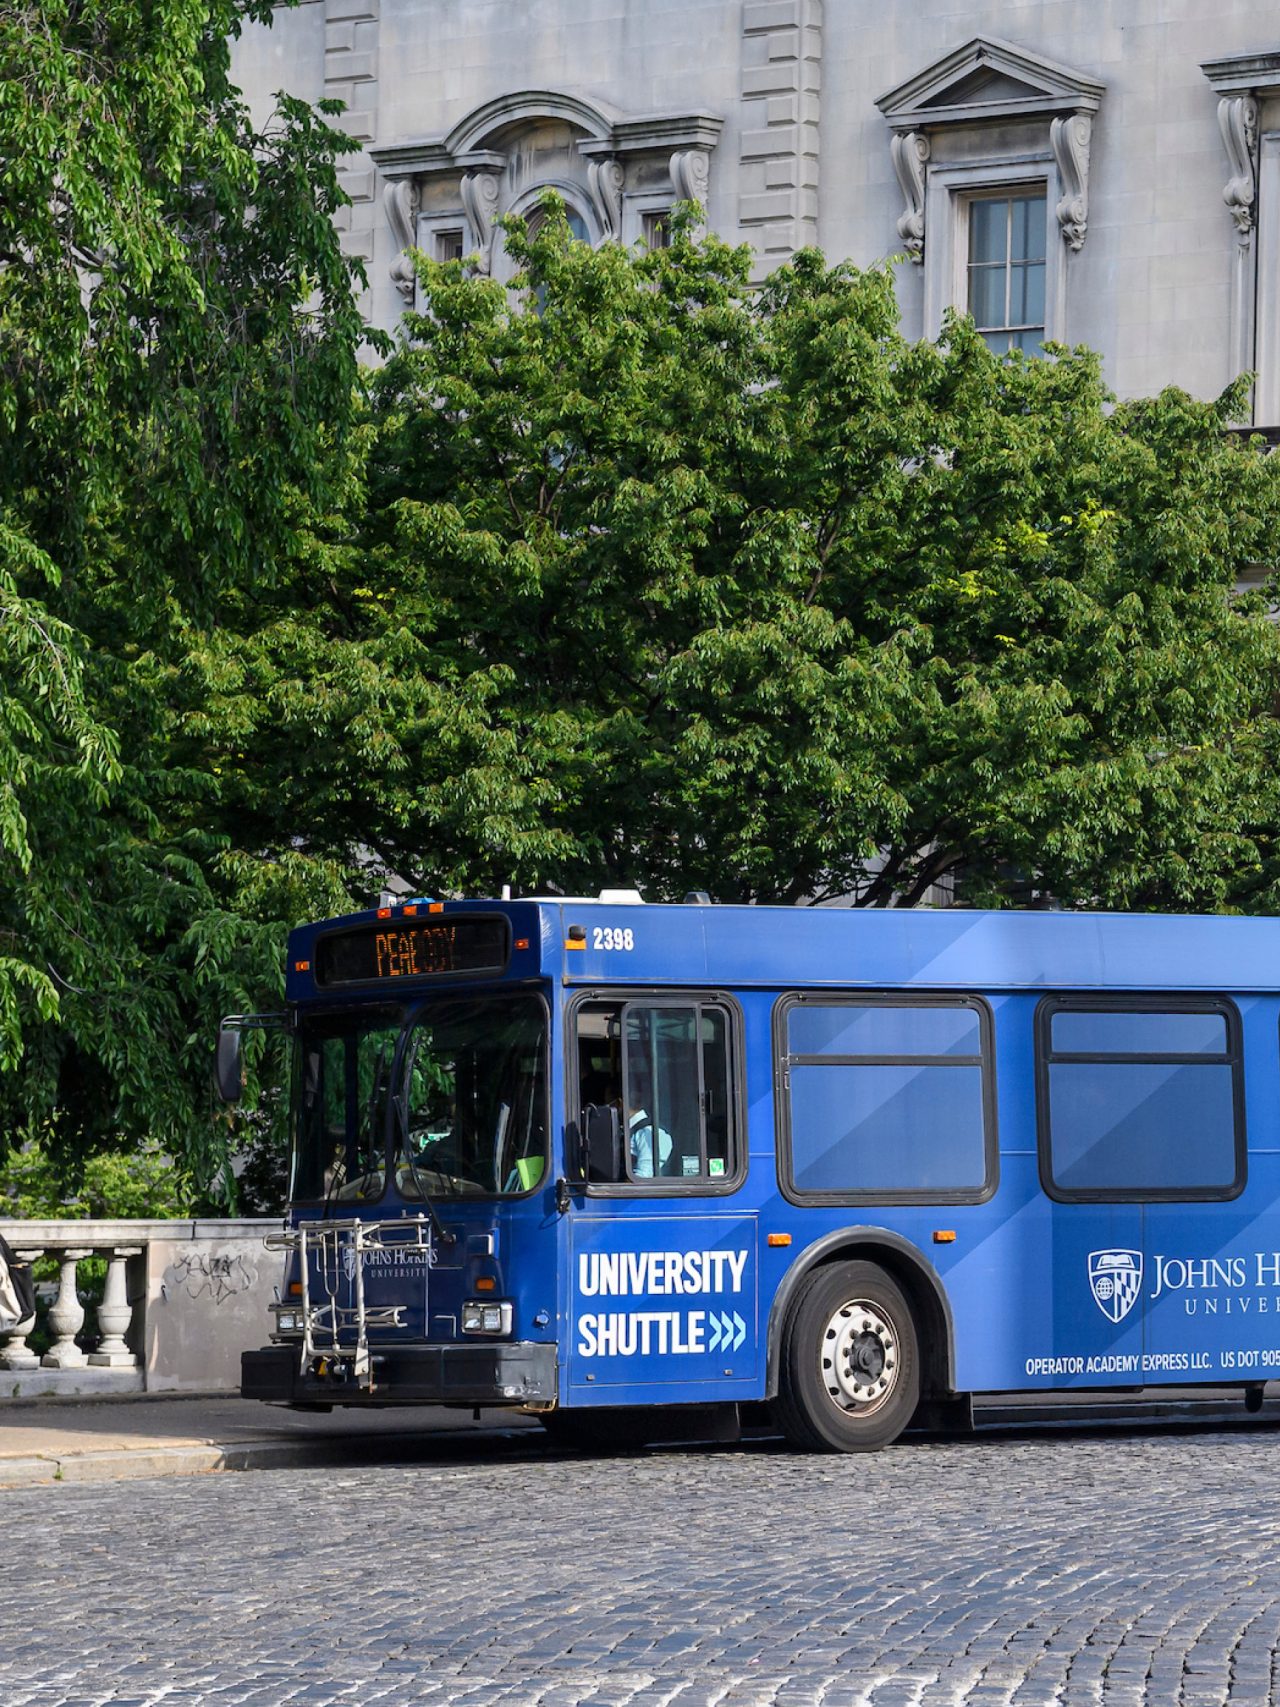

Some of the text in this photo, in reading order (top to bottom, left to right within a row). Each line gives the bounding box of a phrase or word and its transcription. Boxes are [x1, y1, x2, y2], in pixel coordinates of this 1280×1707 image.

[375, 926, 456, 977] PEAB
[593, 927, 634, 951] 2398
[371, 1267, 426, 1278] UNIVERSITY
[579, 1250, 748, 1296] UNIVERSITY
[1150, 1255, 1246, 1298] JOHNS
[577, 1310, 706, 1357] SHUTTLE
[1026, 1358, 1084, 1375] OPERATOR
[1086, 1355, 1139, 1373] ACADEMY
[1142, 1353, 1189, 1371] EXPRESS
[1190, 1352, 1213, 1369] LLC.
[1220, 1351, 1235, 1368] US
[1237, 1350, 1259, 1367] DOT
